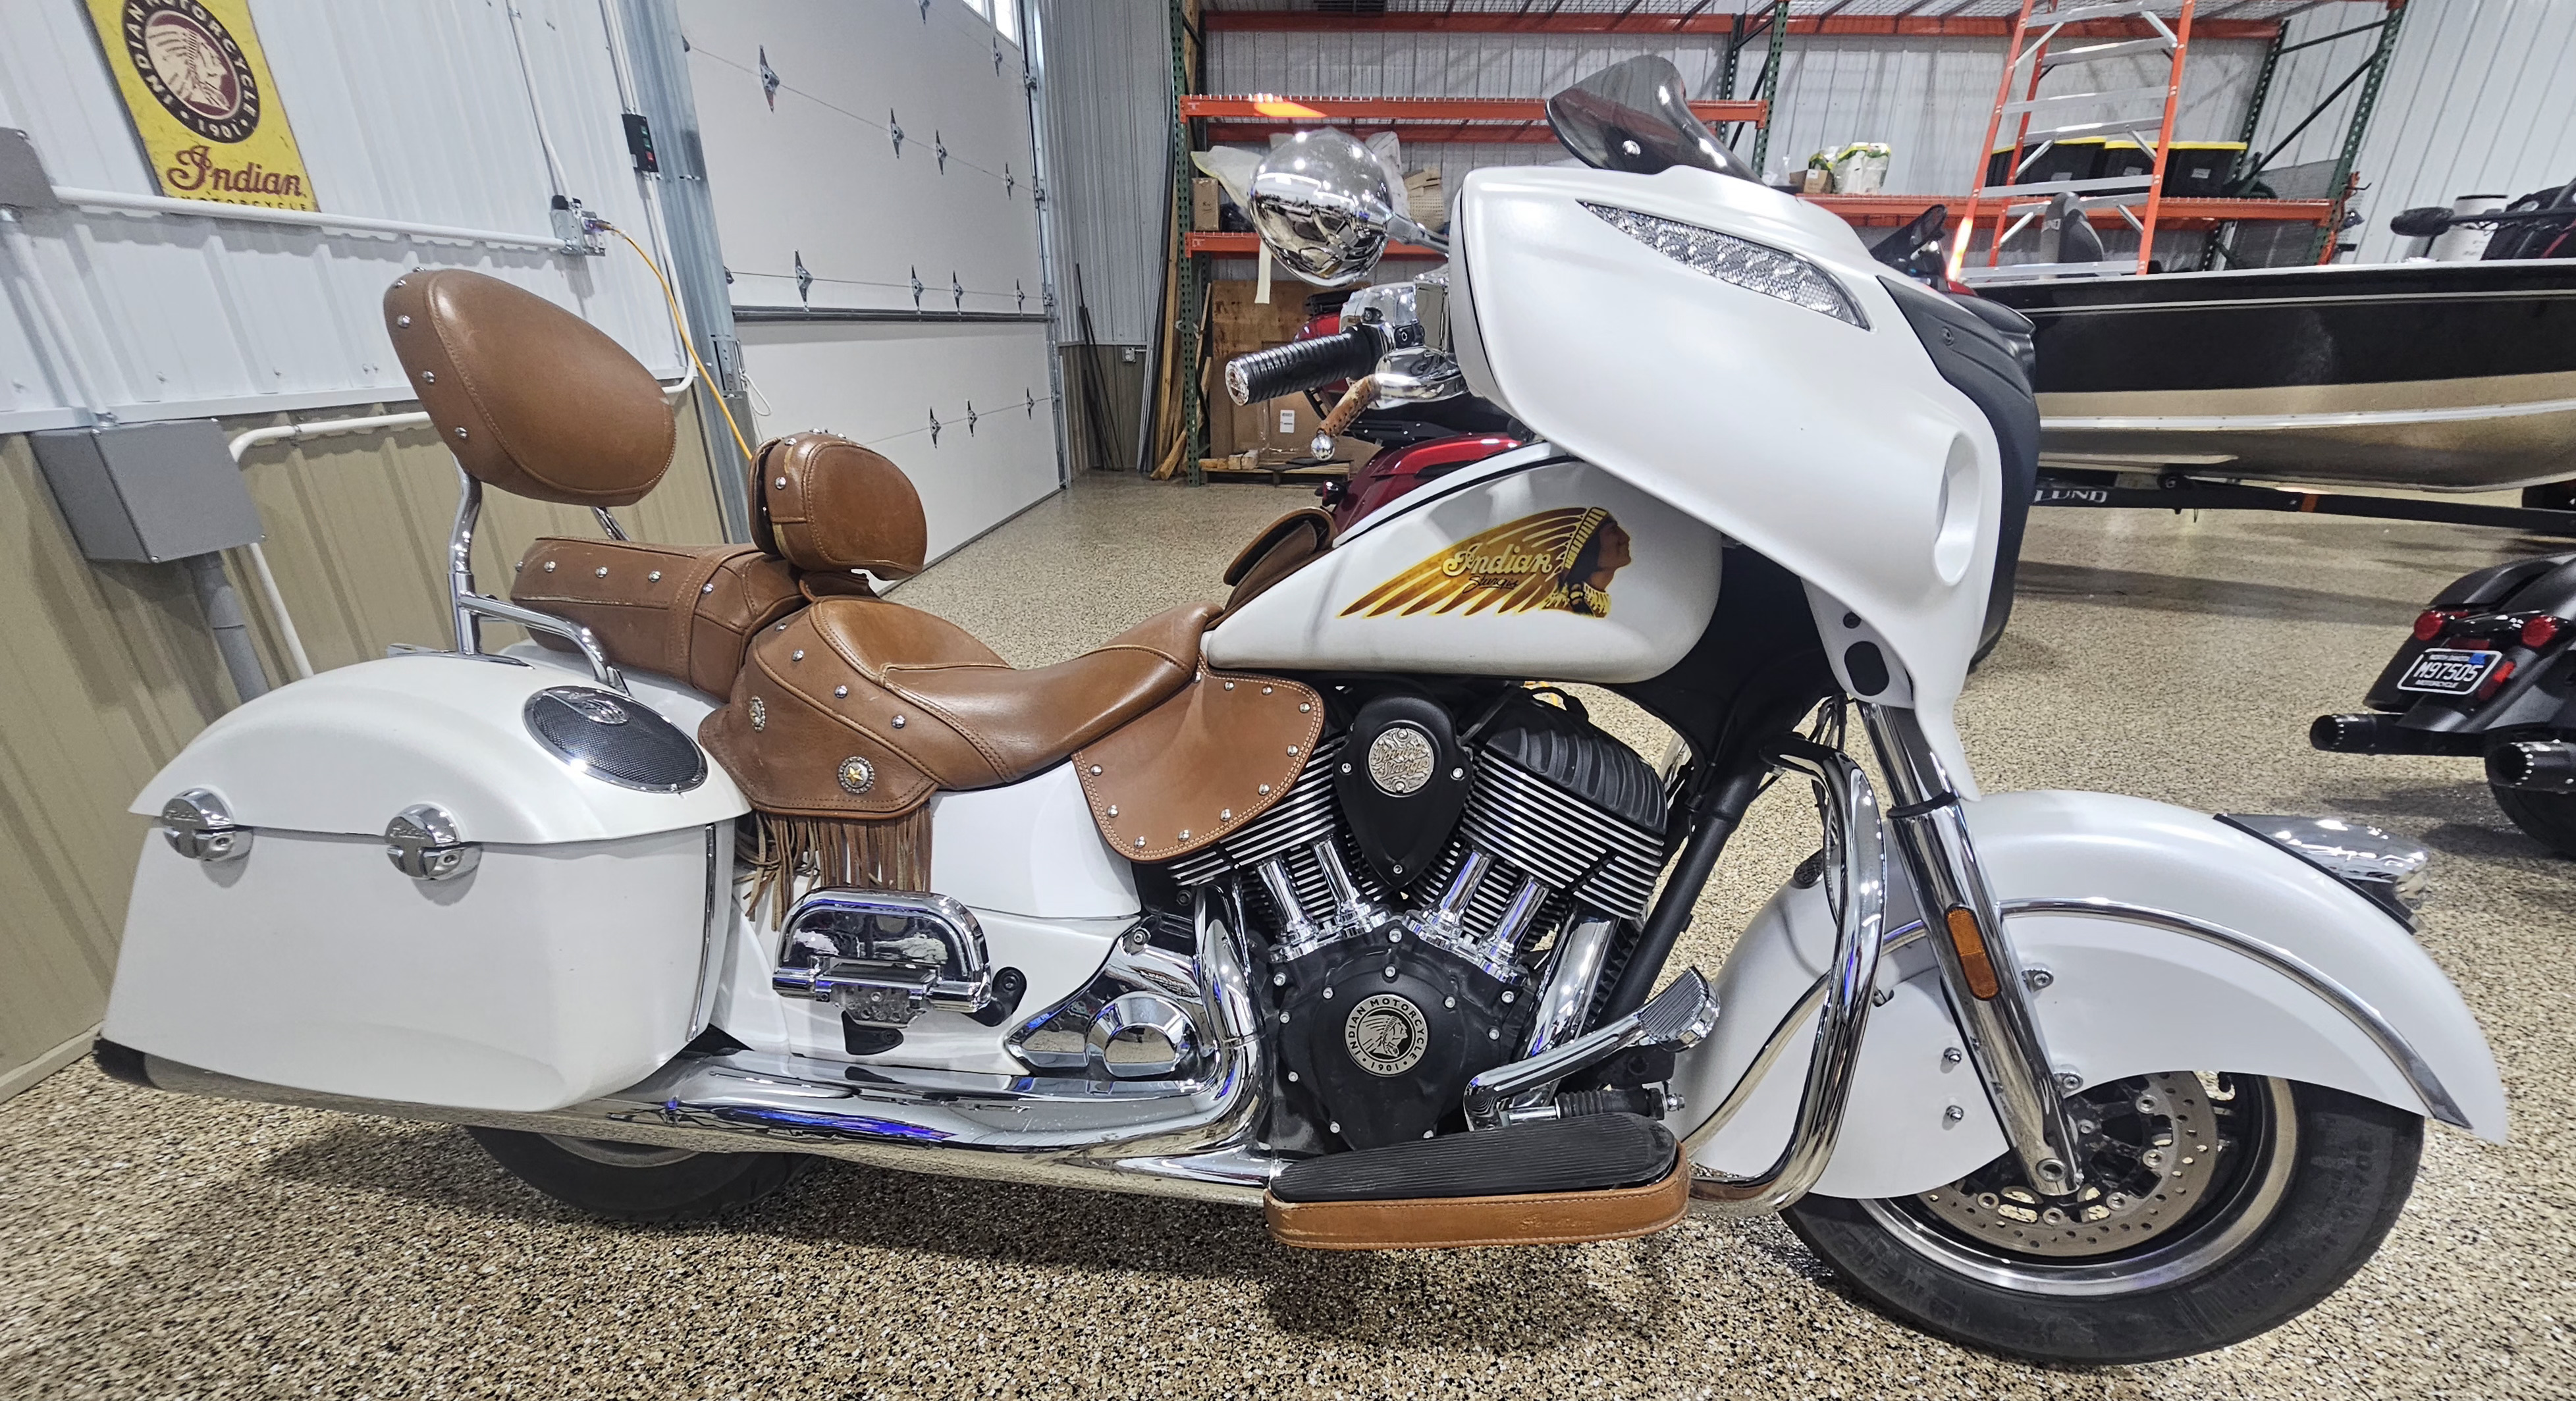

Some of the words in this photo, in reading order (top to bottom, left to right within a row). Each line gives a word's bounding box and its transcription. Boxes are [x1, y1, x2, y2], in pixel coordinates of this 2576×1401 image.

[126, 1, 173, 104] INDIAN
[198, 119, 242, 139] 1901
[166, 145, 302, 197] Indian
[2034, 490, 2106, 503] LUND
[1443, 543, 1552, 577] Indian
[1462, 574, 1518, 594] Sturgis
[2413, 661, 2484, 681] M97505
[1348, 1006, 1366, 1056] INDIAN
[1370, 997, 1425, 1060] MOTORCYCLE
[1370, 1061, 1399, 1072] 1901
